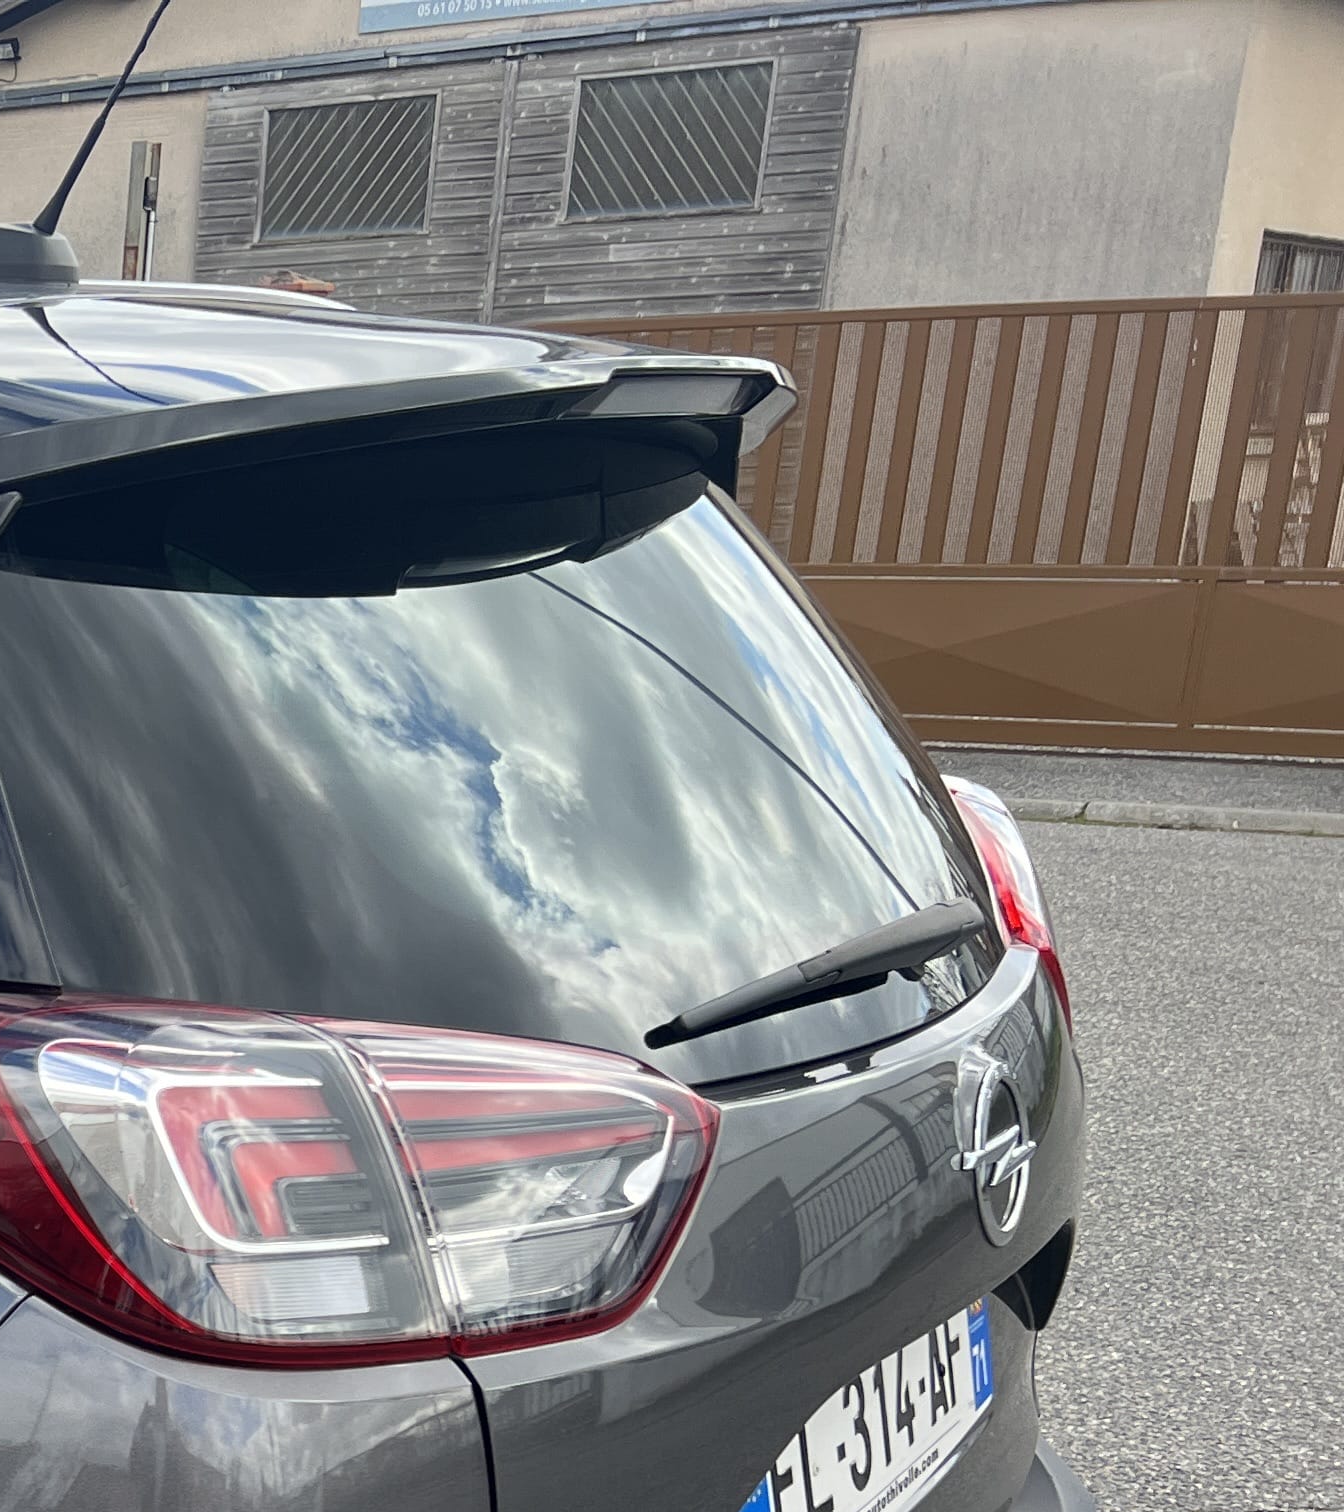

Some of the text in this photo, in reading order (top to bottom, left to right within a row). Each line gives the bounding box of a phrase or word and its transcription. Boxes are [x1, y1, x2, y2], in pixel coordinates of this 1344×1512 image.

[417, 3, 431, 17] 05
[432, 1, 446, 15] 61
[448, 0, 462, 13] 07
[972, 1338, 988, 1392] 71
